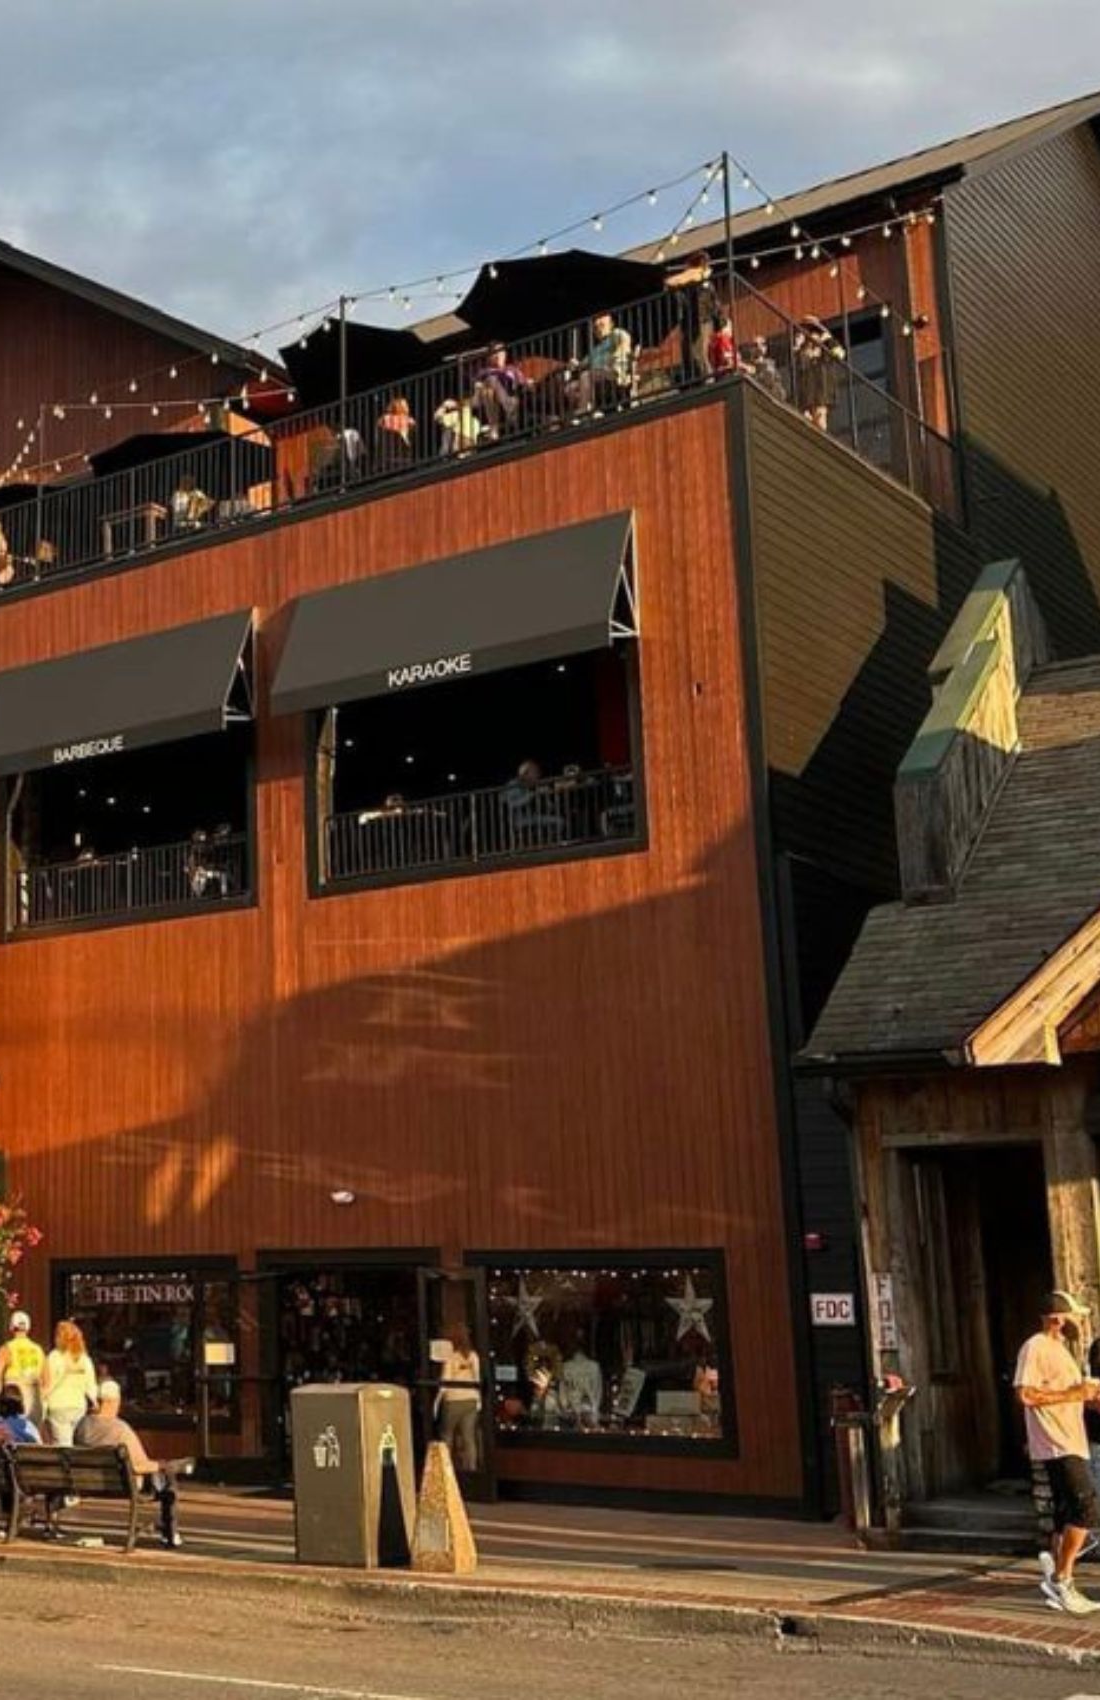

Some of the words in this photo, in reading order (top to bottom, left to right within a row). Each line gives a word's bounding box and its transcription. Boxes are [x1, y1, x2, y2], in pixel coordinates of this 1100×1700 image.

[388, 653, 471, 688] KARAOKE
[53, 734, 123, 764] BARBEQUE
[95, 1286, 129, 1303] THE
[133, 1285, 161, 1302] TIN
[816, 1300, 850, 1318] FDC
